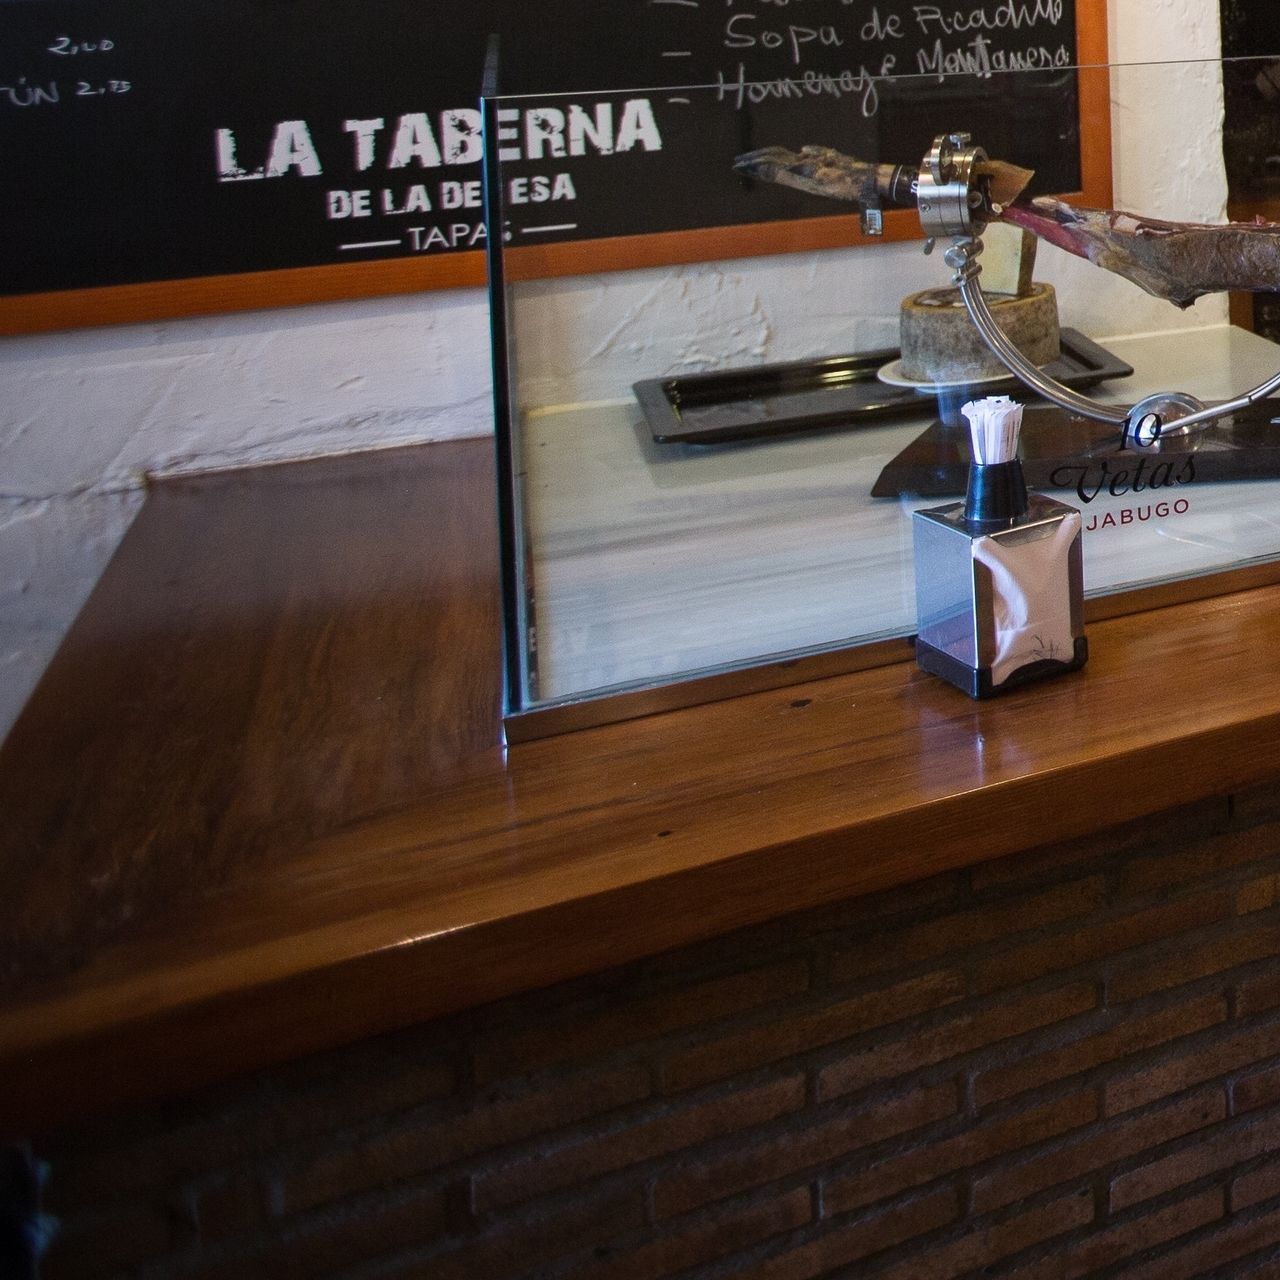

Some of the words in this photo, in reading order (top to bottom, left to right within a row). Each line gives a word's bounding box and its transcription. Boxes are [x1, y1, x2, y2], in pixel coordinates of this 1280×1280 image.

[725, 14, 838, 63] Sopa
[861, 7, 904, 41] de
[215, 119, 323, 182] LA
[346, 99, 663, 170] TABERNA
[326, 188, 372, 219] DE
[384, 185, 432, 215] LA
[441, 172, 577, 211] DEESA
[1118, 412, 1162, 452] 10
[1050, 453, 1196, 505] Vetas
[1085, 498, 1191, 532] JABUGO
